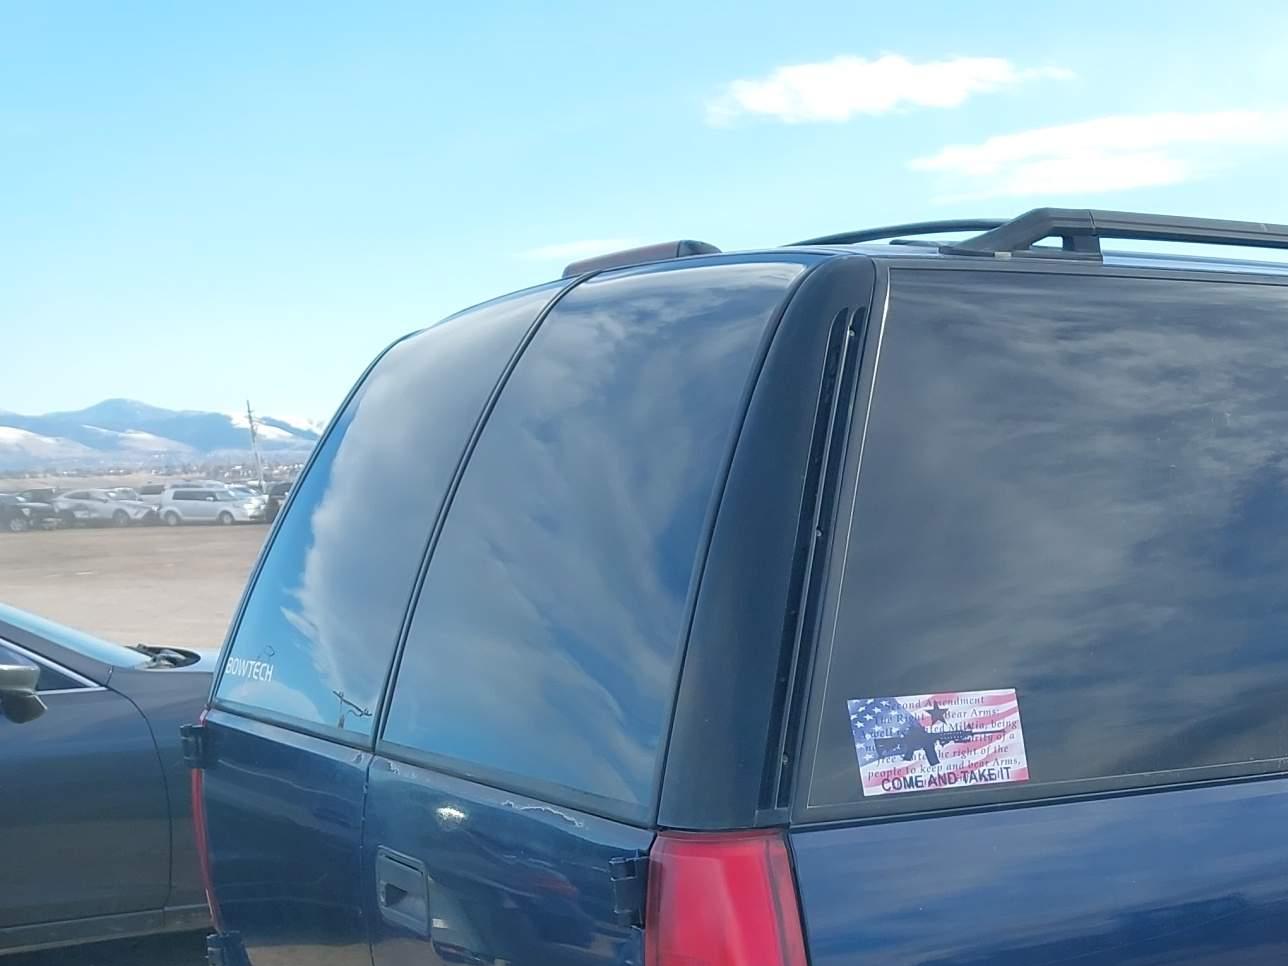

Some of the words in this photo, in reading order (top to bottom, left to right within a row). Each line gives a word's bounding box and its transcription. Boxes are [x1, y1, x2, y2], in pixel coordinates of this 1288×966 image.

[225, 657, 274, 682] BOWTECH
[990, 719, 1017, 732] being
[952, 747, 978, 760] right
[979, 745, 991, 755] of
[993, 744, 1009, 754] the
[867, 766, 902, 782] people
[905, 765, 916, 774] to
[919, 762, 944, 776] keep
[945, 760, 965, 771] and
[881, 774, 925, 792] COME
[925, 771, 957, 788] AND
[961, 768, 996, 785] TAKE
[999, 766, 1013, 781] IT
